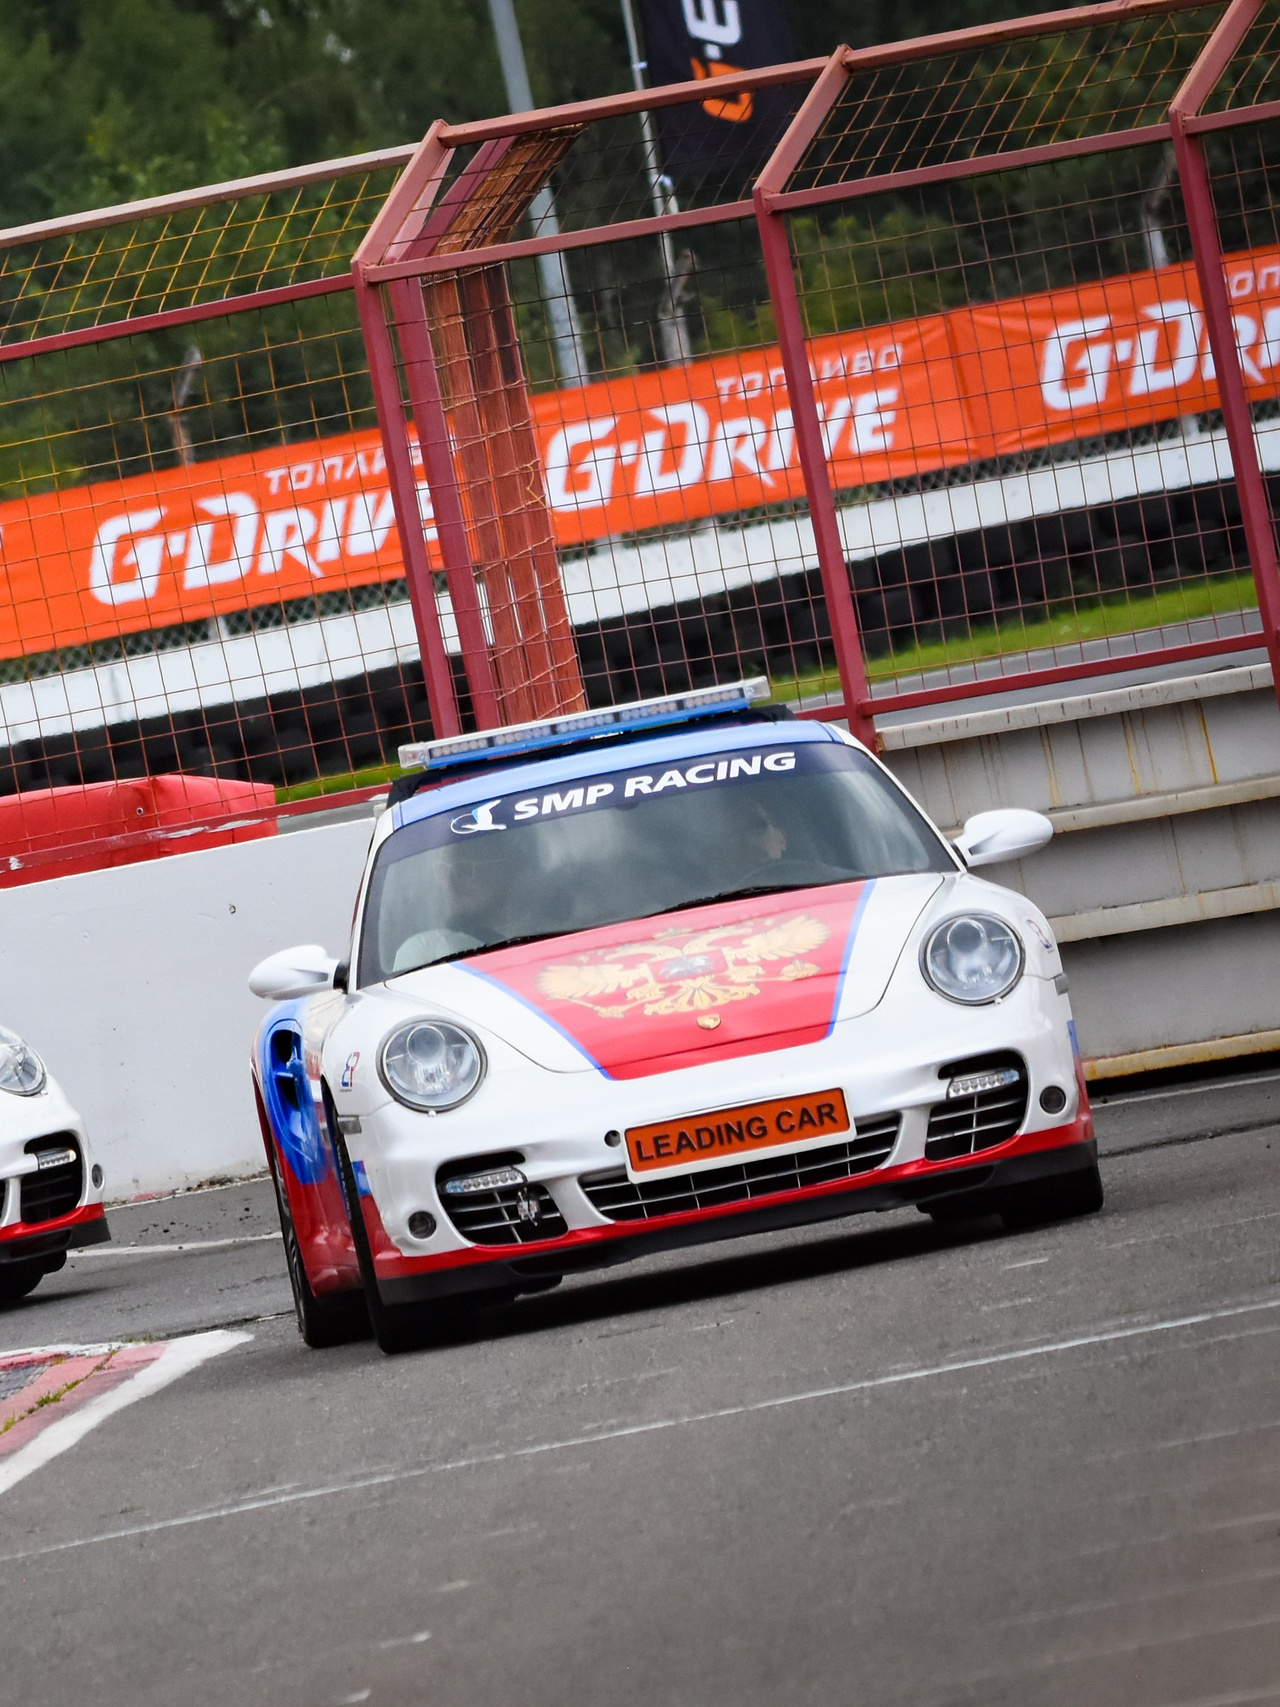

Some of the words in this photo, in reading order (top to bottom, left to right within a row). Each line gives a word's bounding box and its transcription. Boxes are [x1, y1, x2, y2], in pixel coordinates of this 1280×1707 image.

[1222, 265, 1280, 299] ОП
[514, 783, 614, 821] SMP
[624, 751, 796, 798] RACING
[635, 1115, 768, 1162] LEADING
[775, 1102, 839, 1134] CAR
